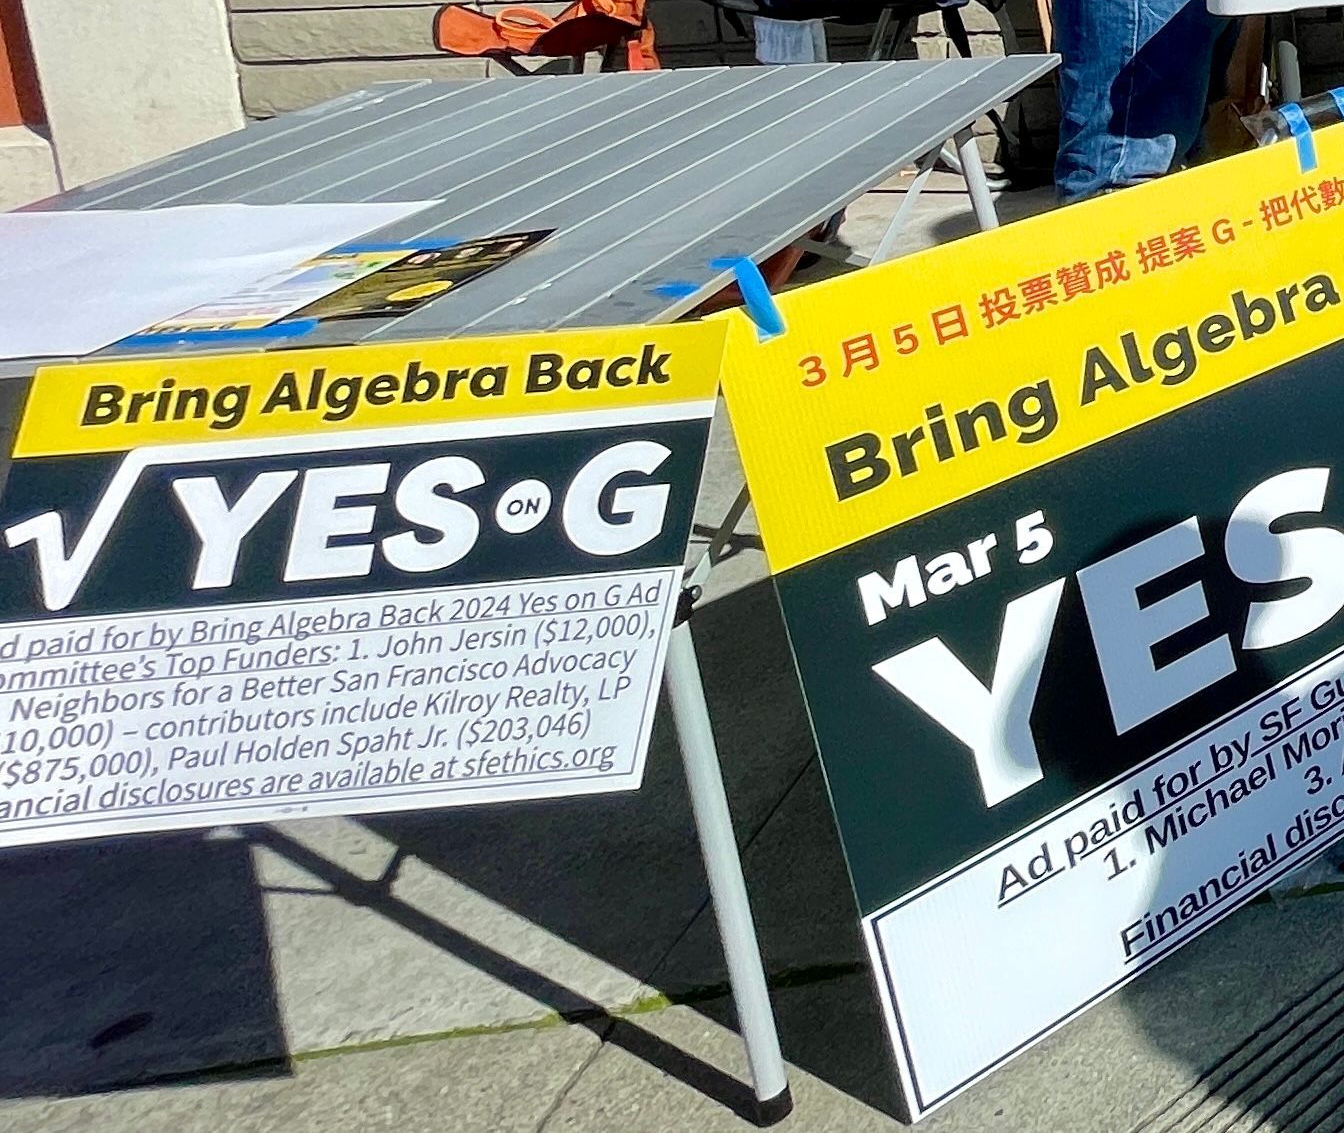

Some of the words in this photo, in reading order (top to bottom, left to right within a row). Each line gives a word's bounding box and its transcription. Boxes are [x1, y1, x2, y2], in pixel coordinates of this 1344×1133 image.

[1137, 225, 1206, 274] 提案
[1212, 218, 1234, 245] G
[81, 377, 249, 429] Bring
[260, 365, 509, 420] Algebra
[524, 344, 672, 393] Back
[825, 379, 1058, 502] Bring
[1080, 272, 1341, 407] Algebra
[171, 455, 486, 592] YES
[506, 497, 542, 517] ON
[562, 440, 673, 557] G
[857, 529, 1000, 626] Mar
[1015, 509, 1055, 565] 5
[0, 634, 20, 659] d
[26, 627, 95, 663] paid
[103, 624, 144, 651] for
[151, 622, 183, 651] by
[190, 617, 264, 645] Bring
[268, 605, 370, 641] Algebra
[379, 600, 442, 627] Back
[449, 593, 512, 621] 2024
[519, 592, 557, 614] Yes
[565, 592, 595, 610] on
[604, 584, 621, 606] G
[627, 579, 663, 605] Ad
[0, 654, 156, 689] mmittee's
[166, 652, 215, 680] Top
[222, 644, 341, 671] Funders:
[348, 639, 369, 660] 1.
[377, 630, 443, 659] John
[450, 624, 527, 653] Jersin
[533, 610, 656, 649] ($12,000),
[0, 720, 114, 756] 10,000)
[145, 707, 314, 742] contributors
[321, 694, 418, 726] include
[424, 686, 500, 719] Kilroy
[505, 680, 589, 710] Realty,
[598, 676, 632, 702] LP
[10, 688, 165, 723] Neighbors
[172, 682, 213, 707] for
[217, 685, 233, 703] a
[241, 674, 326, 701] Better
[329, 668, 379, 693] San
[386, 659, 508, 689] Francisco
[512, 649, 637, 678] Advocacy
[0, 786, 91, 818] ancial
[99, 775, 251, 811] disclosures
[260, 772, 303, 793] are
[309, 757, 425, 791] available
[430, 758, 455, 779] at
[461, 743, 618, 774] sfethics.org
[168, 741, 227, 771] Paul
[234, 734, 330, 764] Holden
[336, 727, 414, 760] Spaht
[417, 727, 448, 750] Jr.
[458, 709, 592, 750] ($203,046)
[1304, 766, 1332, 794] 3.
[998, 843, 1054, 901] Ad
[1064, 789, 1146, 869] paid
[1152, 761, 1203, 805] for
[1211, 732, 1251, 774] by
[1259, 698, 1302, 742] SF
[1103, 847, 1138, 880] 1.
[1144, 756, 1276, 854] Michael
[1119, 835, 1277, 957] Financial
